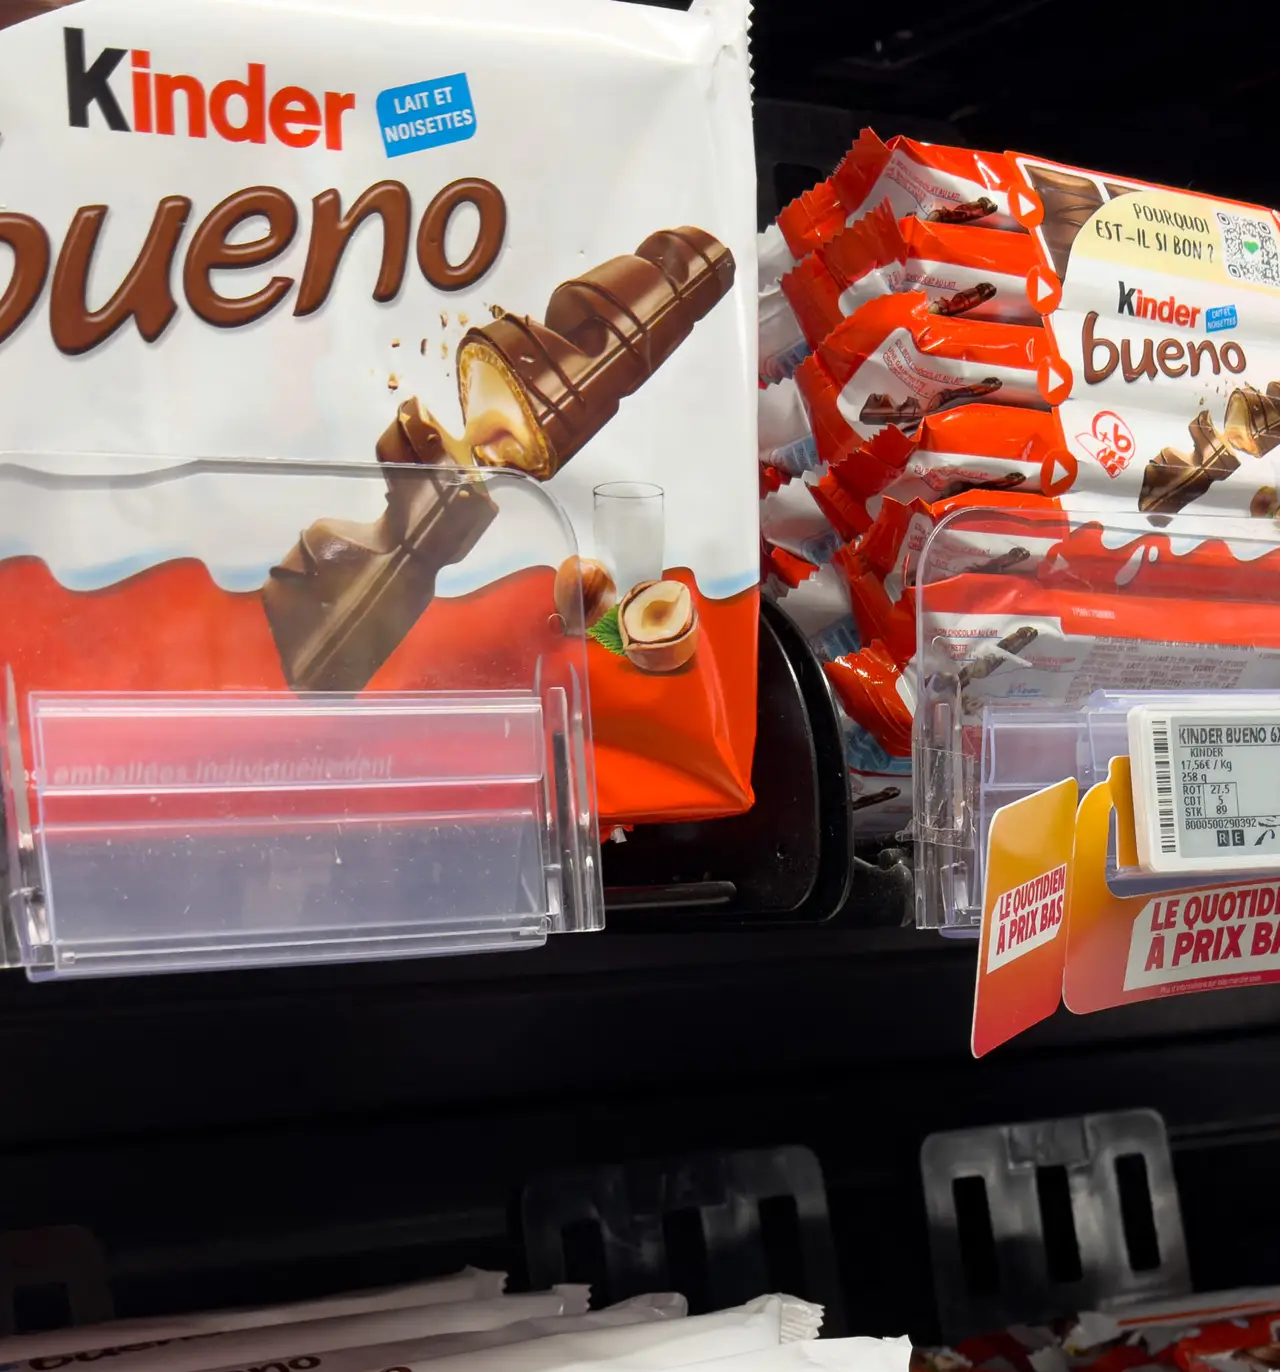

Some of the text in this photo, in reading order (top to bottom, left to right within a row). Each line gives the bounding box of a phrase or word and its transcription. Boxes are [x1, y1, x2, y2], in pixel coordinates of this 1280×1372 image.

[63, 27, 356, 151] Kinder
[393, 86, 453, 114] LAIT ET
[384, 108, 473, 143] NOISETTES
[1133, 202, 1210, 234] POURQUOI
[1155, 232, 1168, 252] SI
[1173, 236, 1203, 260] BON
[1117, 280, 1201, 328] Kinder
[1081, 311, 1247, 385] bueno
[1178, 726, 1223, 745] KINDER
[1225, 726, 1267, 744] BUENO
[1181, 759, 1211, 771] 17,56€
[1220, 759, 1232, 772] Kg
[1190, 748, 1223, 758] KINDER
[1181, 772, 1198, 782] 258
[1182, 784, 1231, 796] ROT 27.5
[1185, 805, 1228, 818] STK 89
[1218, 795, 1224, 806] 5
[998, 865, 1066, 921] LE QUOTIDIEN
[996, 896, 1064, 956] À PRIX BAS
[1150, 902, 1177, 932] LE
[1144, 932, 1165, 972] À
[1171, 924, 1245, 967] PRIX
